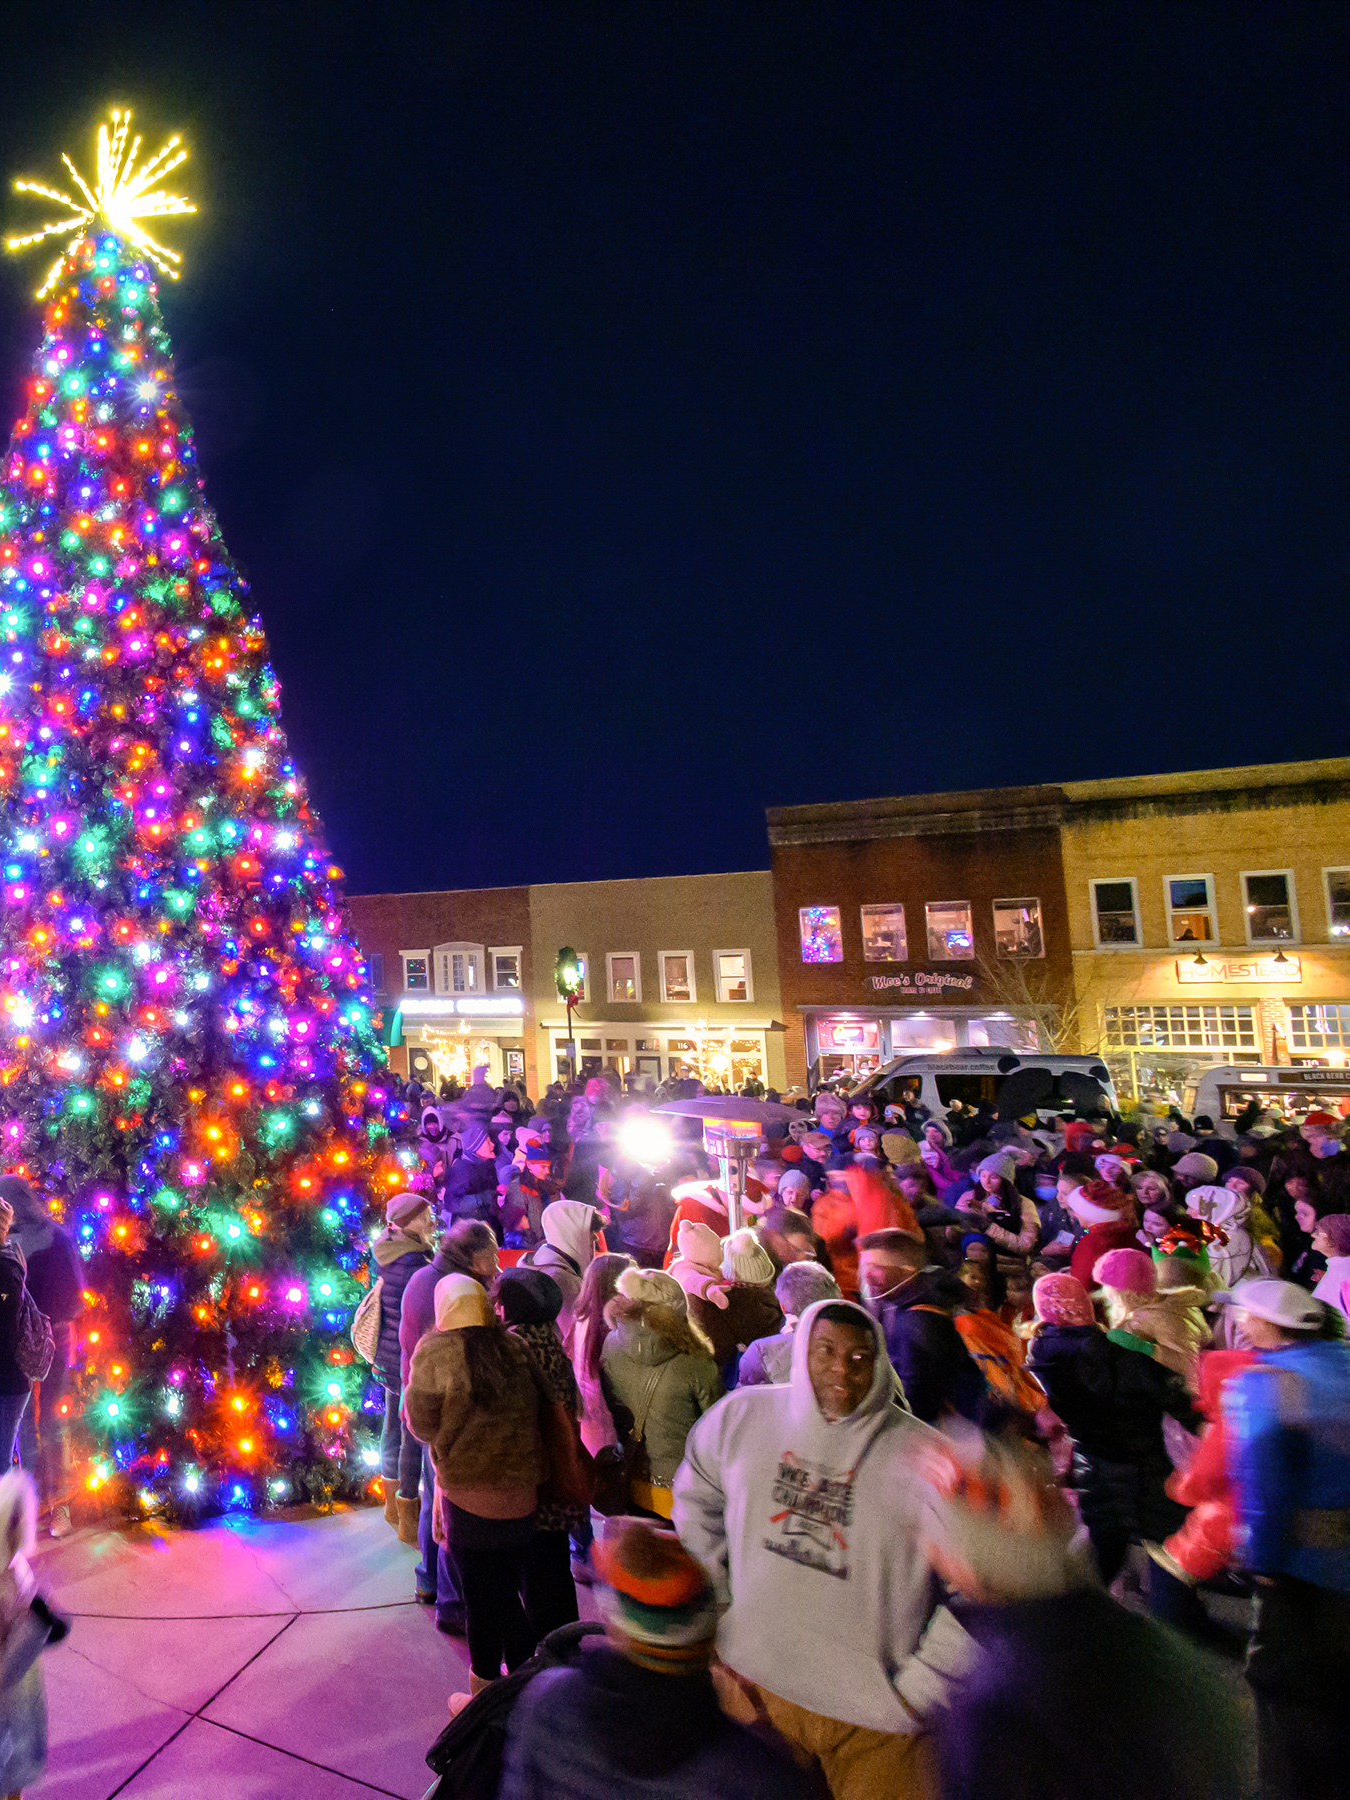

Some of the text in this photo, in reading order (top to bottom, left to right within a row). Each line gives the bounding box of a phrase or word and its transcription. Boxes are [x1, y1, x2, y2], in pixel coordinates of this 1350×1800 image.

[1179, 962, 1299, 979] HOMESTEAD
[872, 972, 973, 989] Moe's Original
